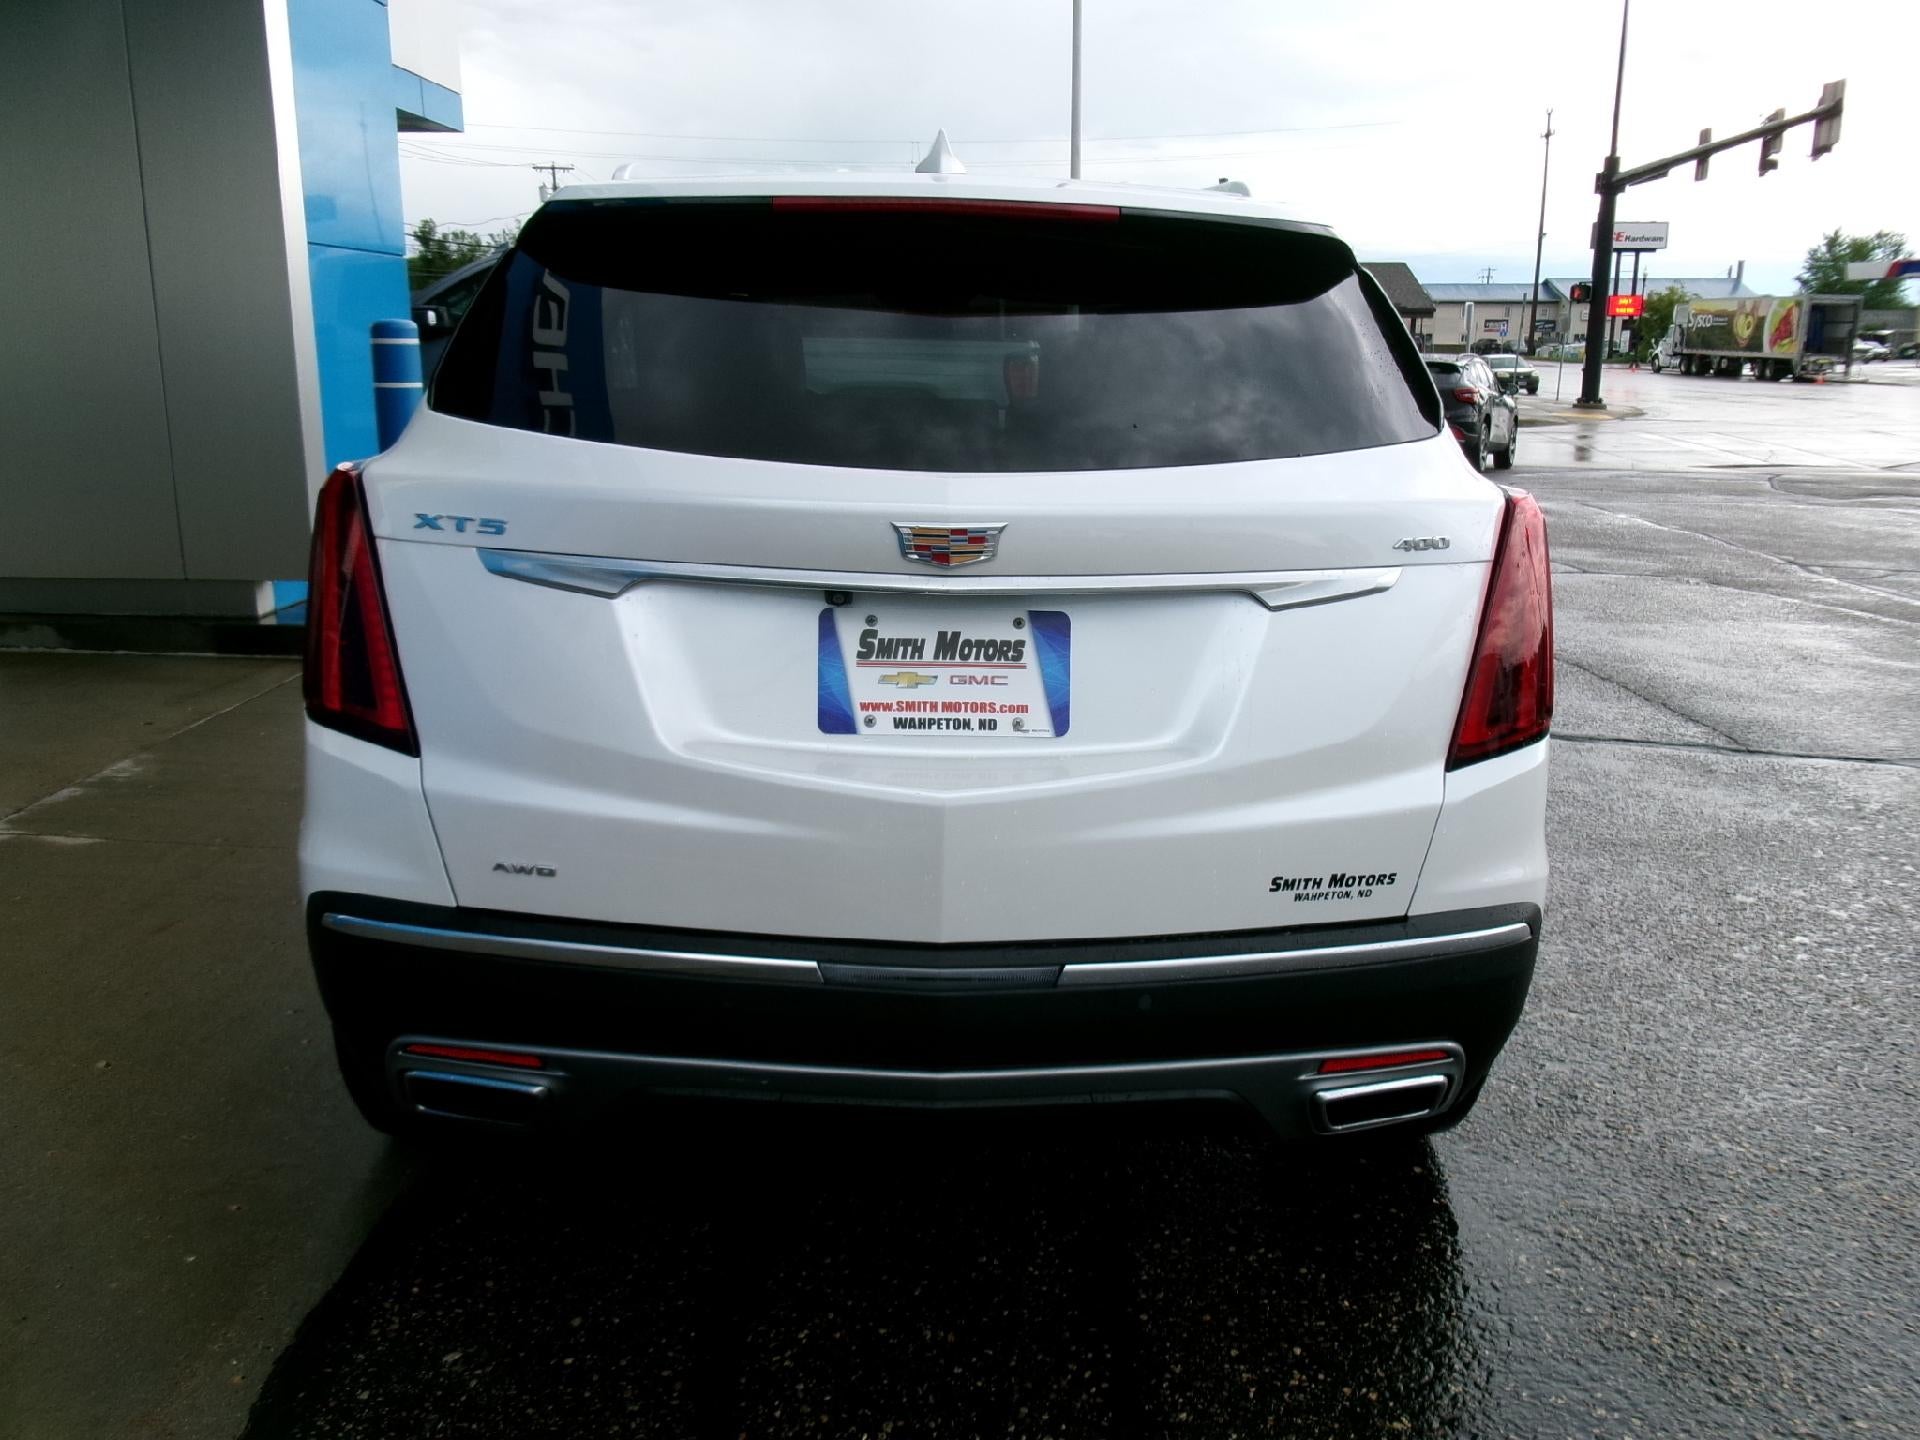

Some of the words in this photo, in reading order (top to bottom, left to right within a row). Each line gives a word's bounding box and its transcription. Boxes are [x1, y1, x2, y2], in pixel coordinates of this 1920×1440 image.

[1625, 234, 1665, 242] Hardware
[413, 513, 507, 535] XT5
[1392, 536, 1450, 552] 400
[856, 628, 926, 661] SMITH
[933, 630, 1026, 662] MOTORS
[949, 674, 1009, 686] GMC
[892, 716, 975, 732] WAHPETON,
[978, 717, 998, 731] ND
[492, 862, 557, 878] AWD
[1269, 876, 1324, 893] SMITH
[1327, 872, 1398, 889] MOTORS
[1293, 890, 1354, 903] WAHPETON,
[1356, 889, 1373, 899] ND
